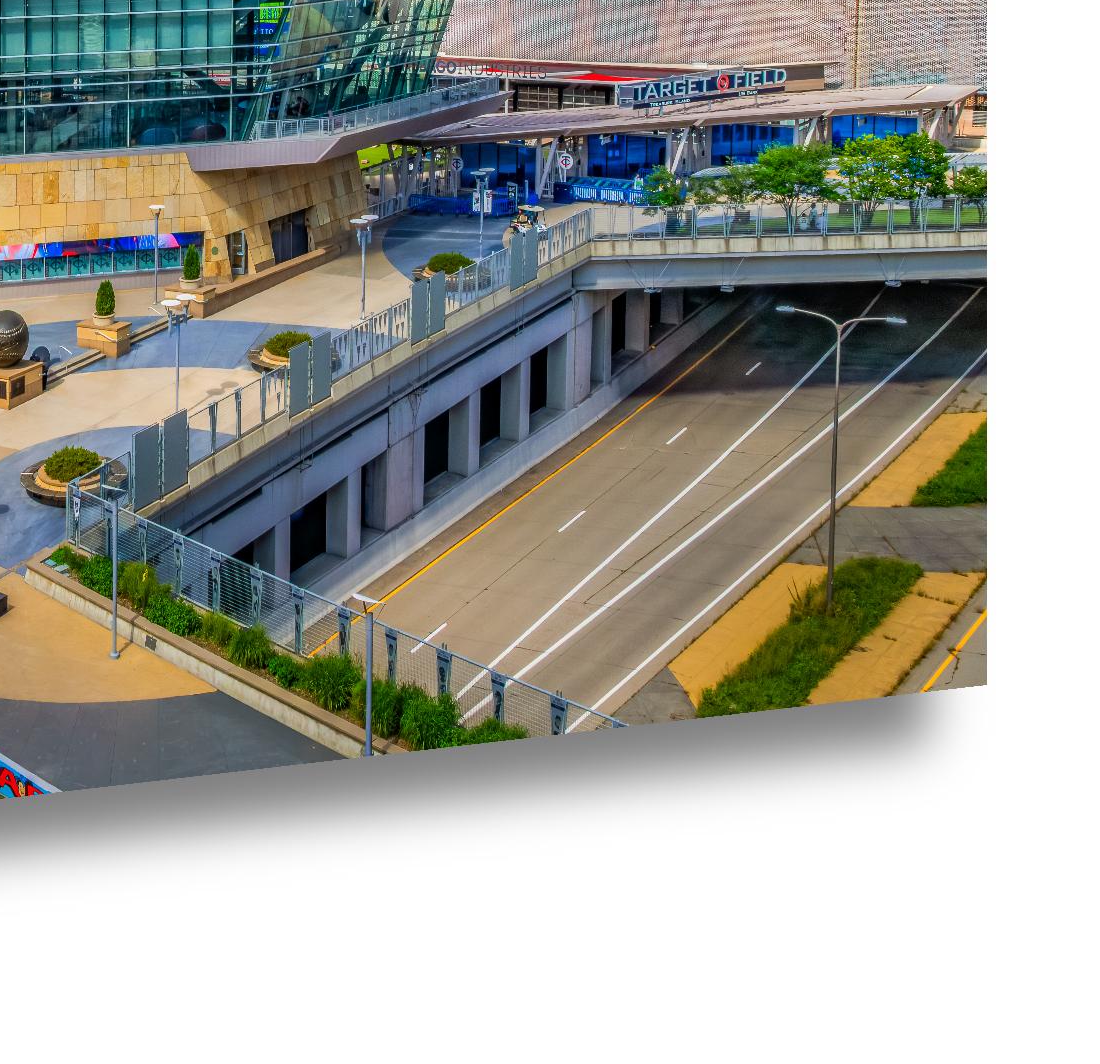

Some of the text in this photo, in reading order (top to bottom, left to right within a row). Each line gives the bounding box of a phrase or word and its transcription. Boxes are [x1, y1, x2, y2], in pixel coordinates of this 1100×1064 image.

[457, 63, 547, 79] INDUSTRIES
[633, 69, 786, 101] TARGET FIELD
